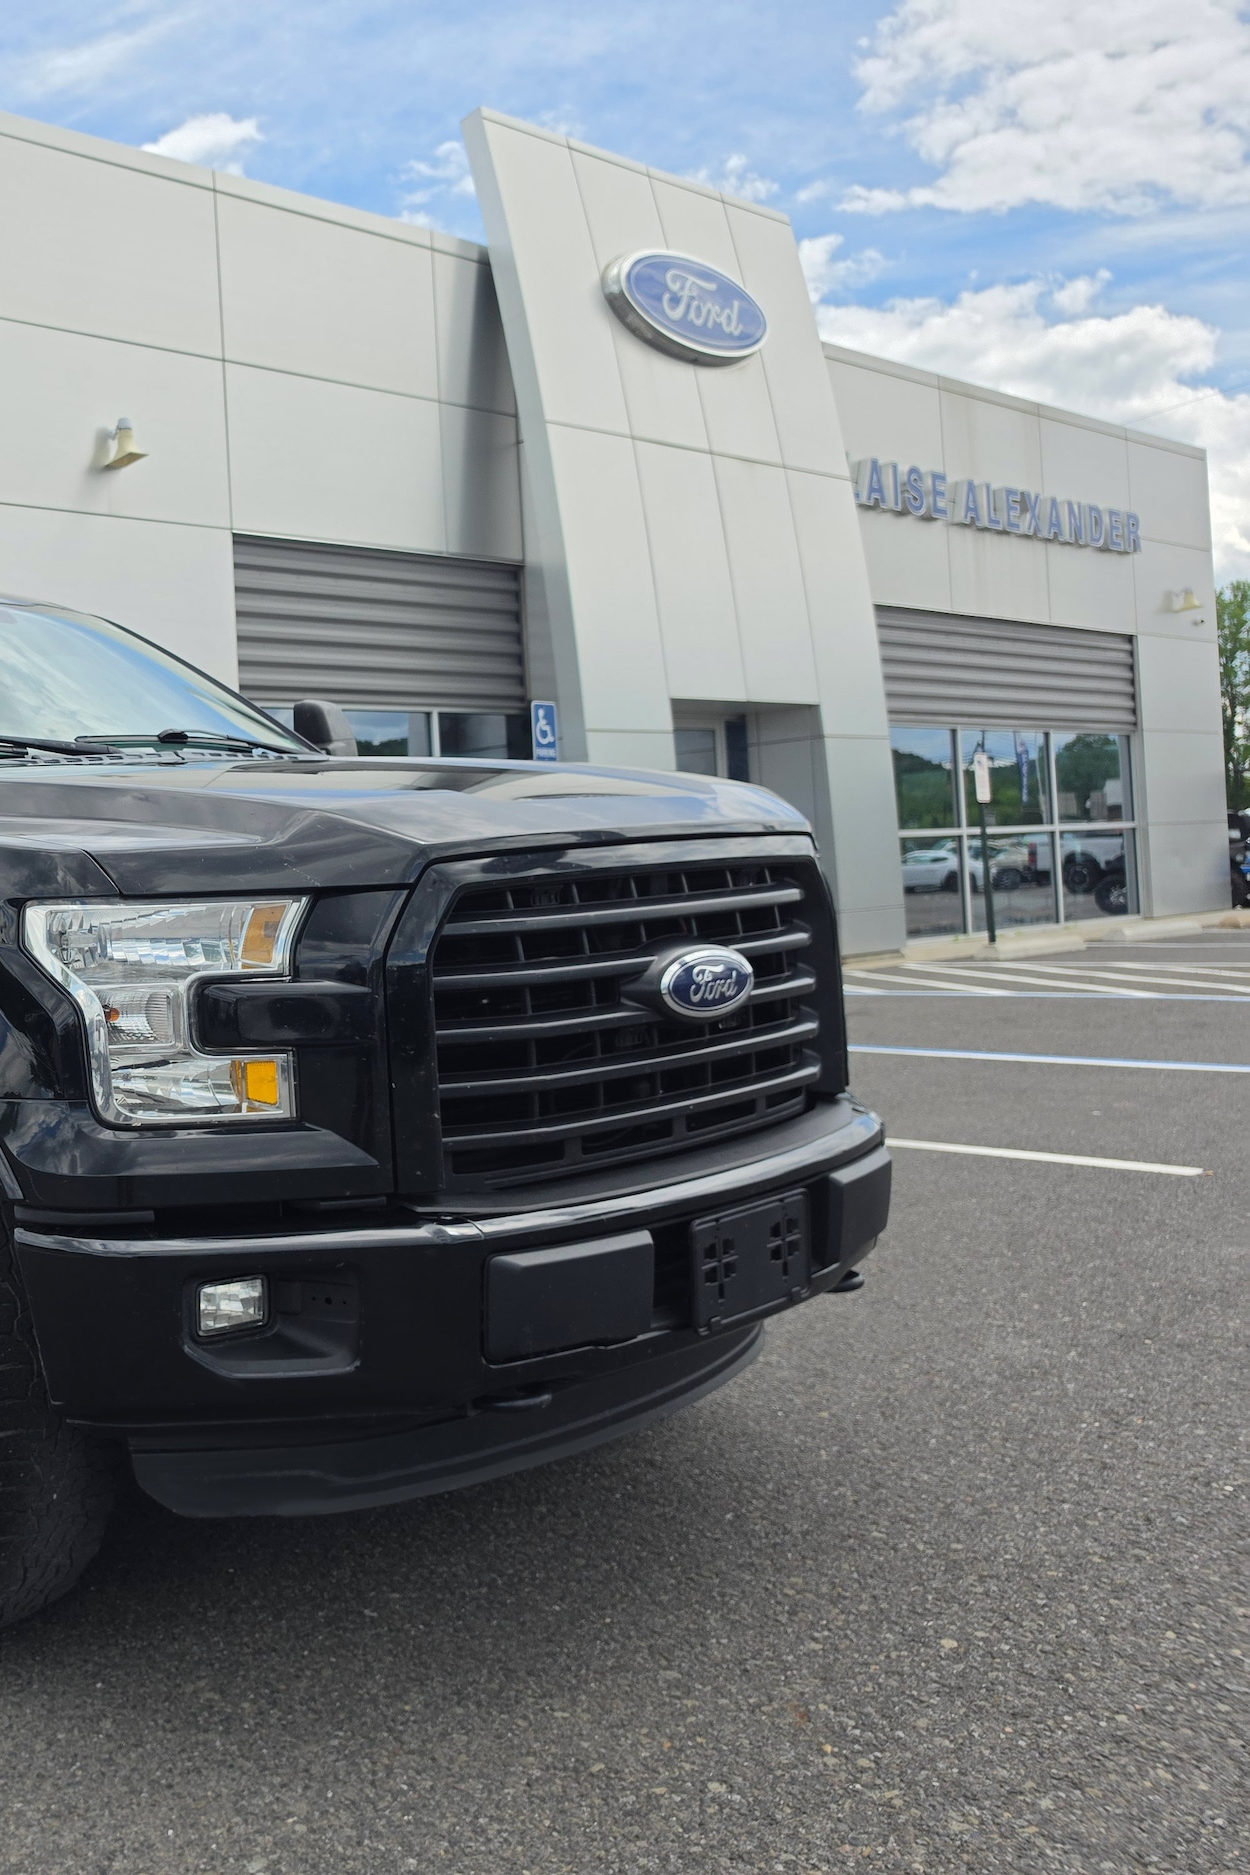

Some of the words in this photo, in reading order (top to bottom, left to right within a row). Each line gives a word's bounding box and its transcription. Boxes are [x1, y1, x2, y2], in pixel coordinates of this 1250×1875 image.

[661, 268, 744, 337] Ford
[853, 456, 949, 520] AISE
[961, 478, 1143, 554] ALEXANDER
[689, 963, 739, 1003] Ford
